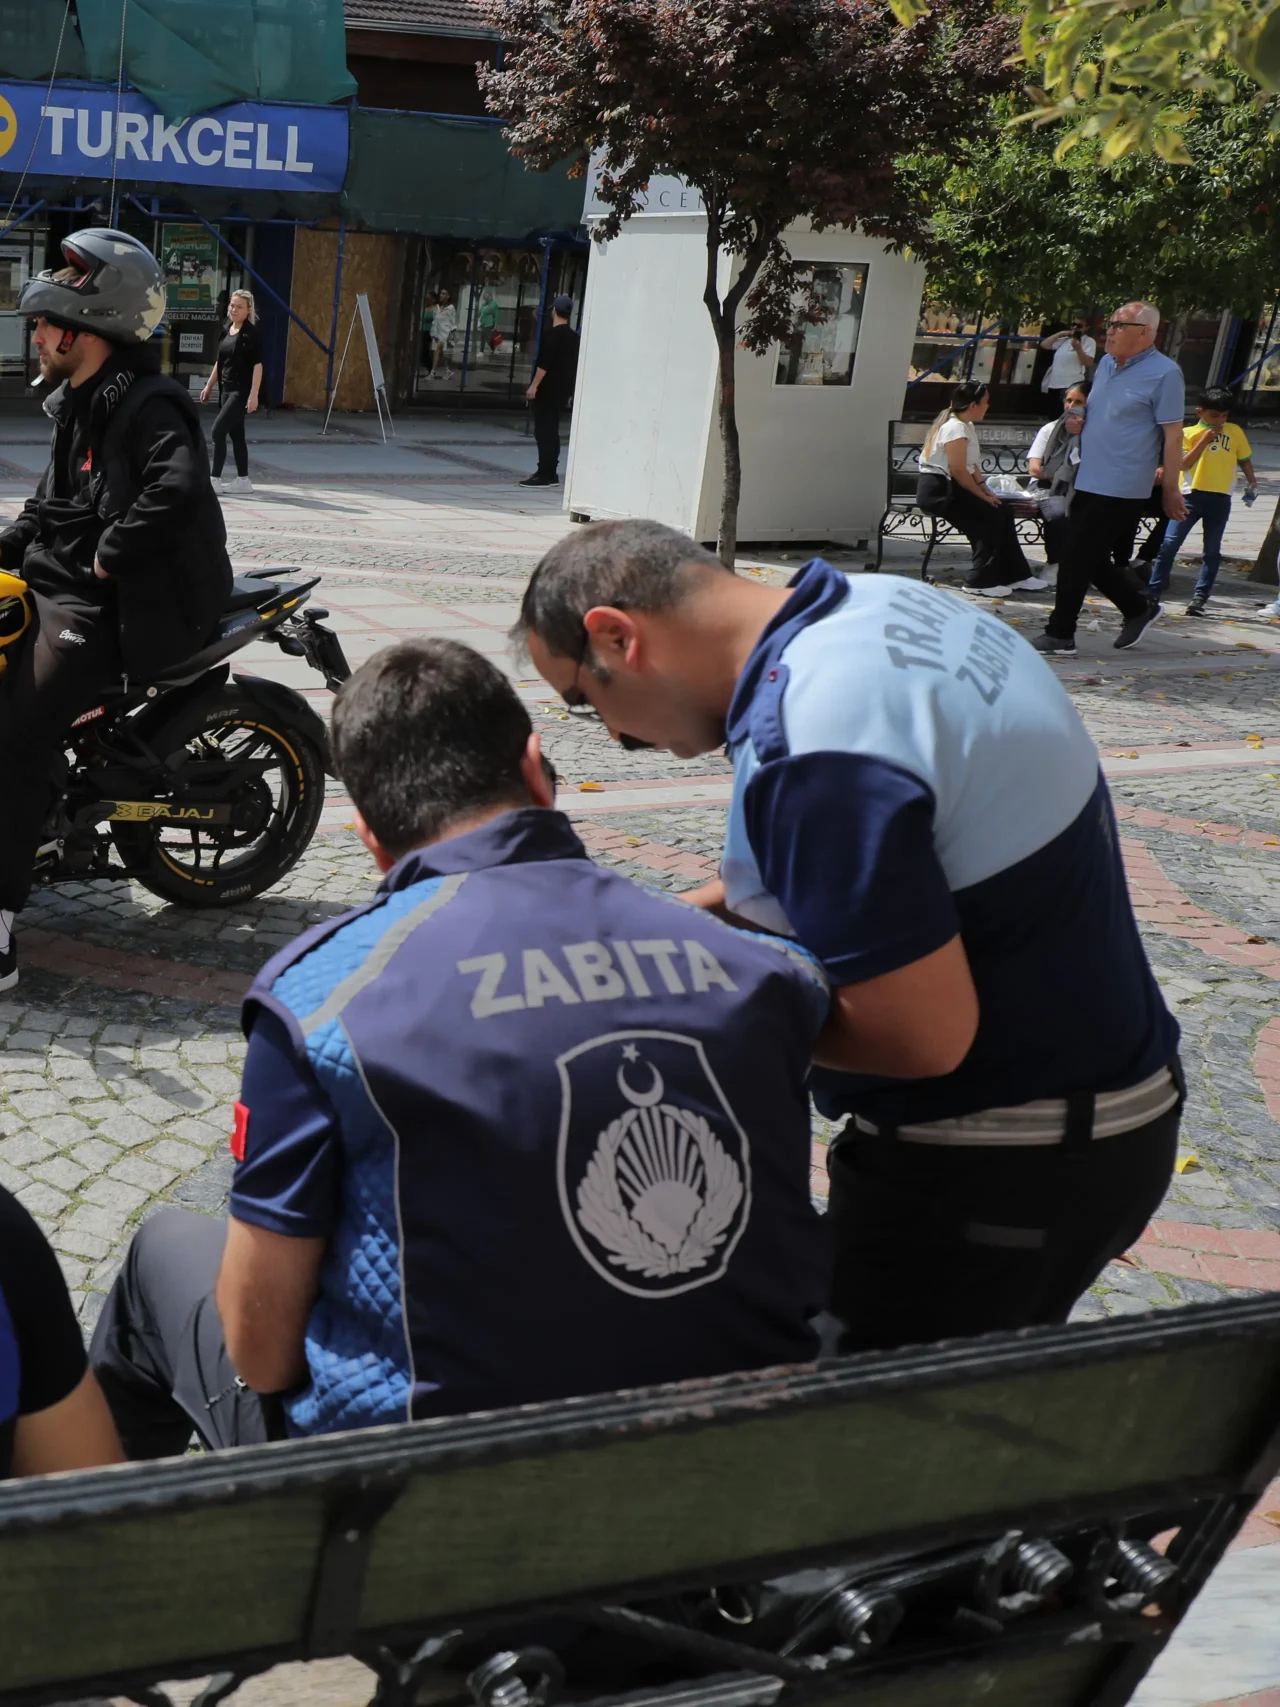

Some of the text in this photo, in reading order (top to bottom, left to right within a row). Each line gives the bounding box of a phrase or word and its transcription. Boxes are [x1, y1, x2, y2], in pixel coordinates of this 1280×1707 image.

[40, 106, 314, 173] TURKCELL
[954, 616, 1017, 706] ZABITA
[205, 708, 240, 722] MRF
[137, 805, 215, 819] BAJAJ
[456, 938, 740, 1020] ZABITA
